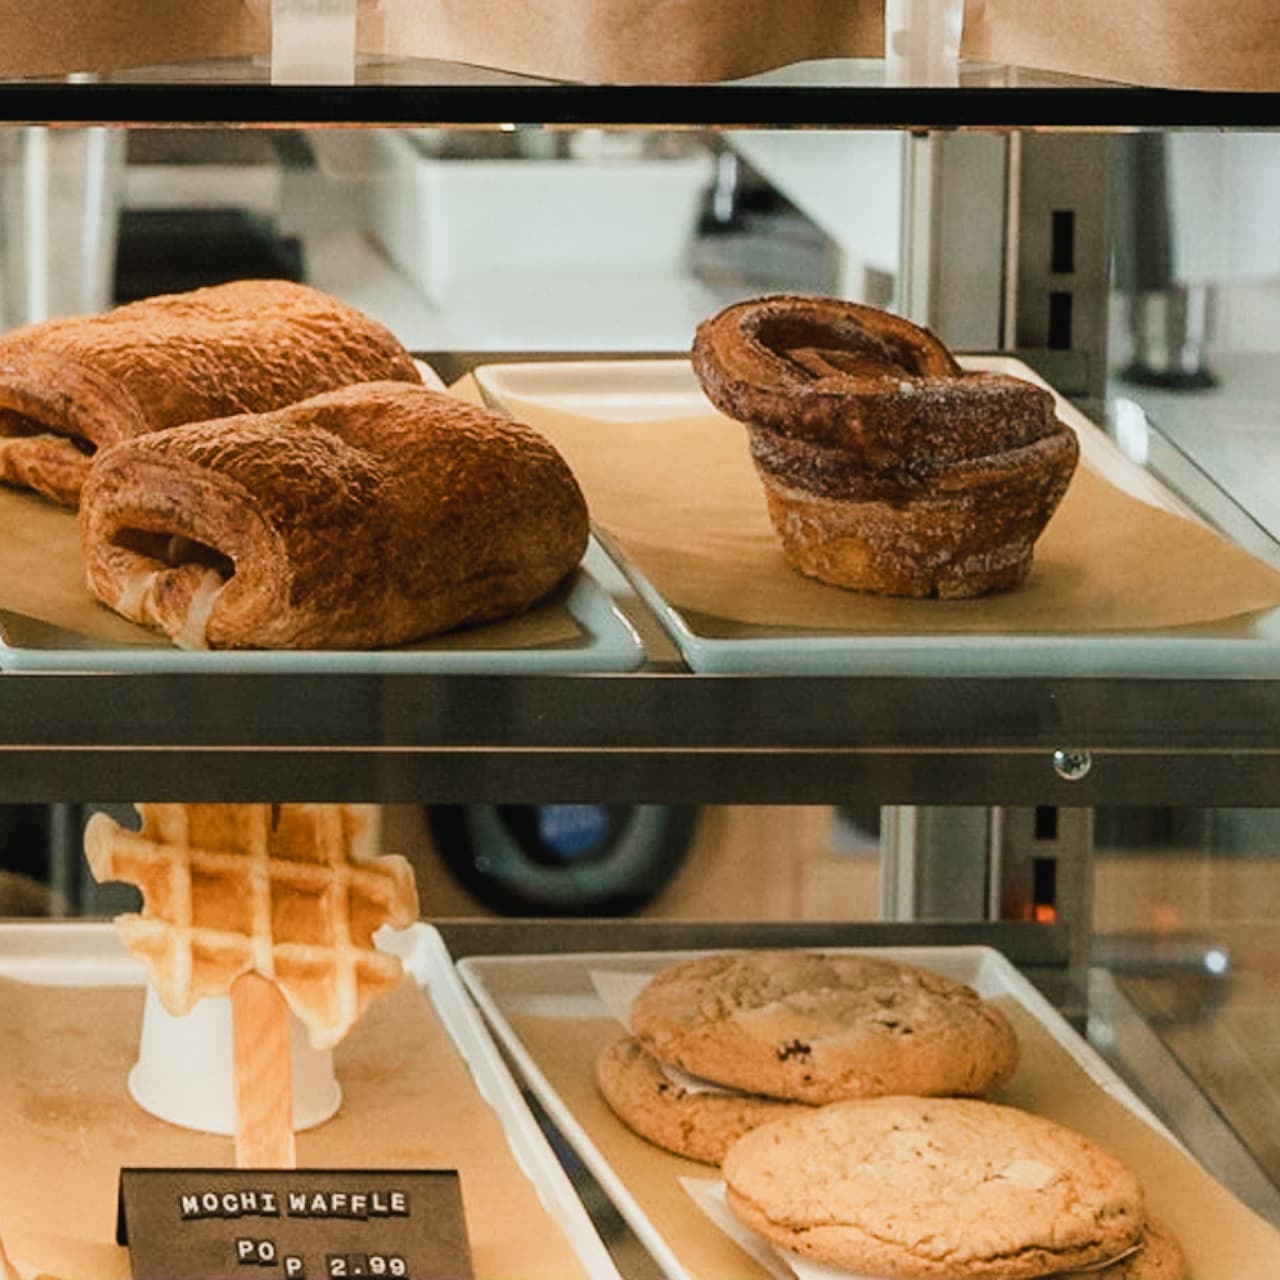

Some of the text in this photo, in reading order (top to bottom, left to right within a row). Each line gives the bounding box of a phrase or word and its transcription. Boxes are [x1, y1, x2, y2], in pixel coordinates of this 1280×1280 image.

[182, 1192, 406, 1213] MOCHI WAFFLE
[330, 1256, 406, 1276] 2.99
